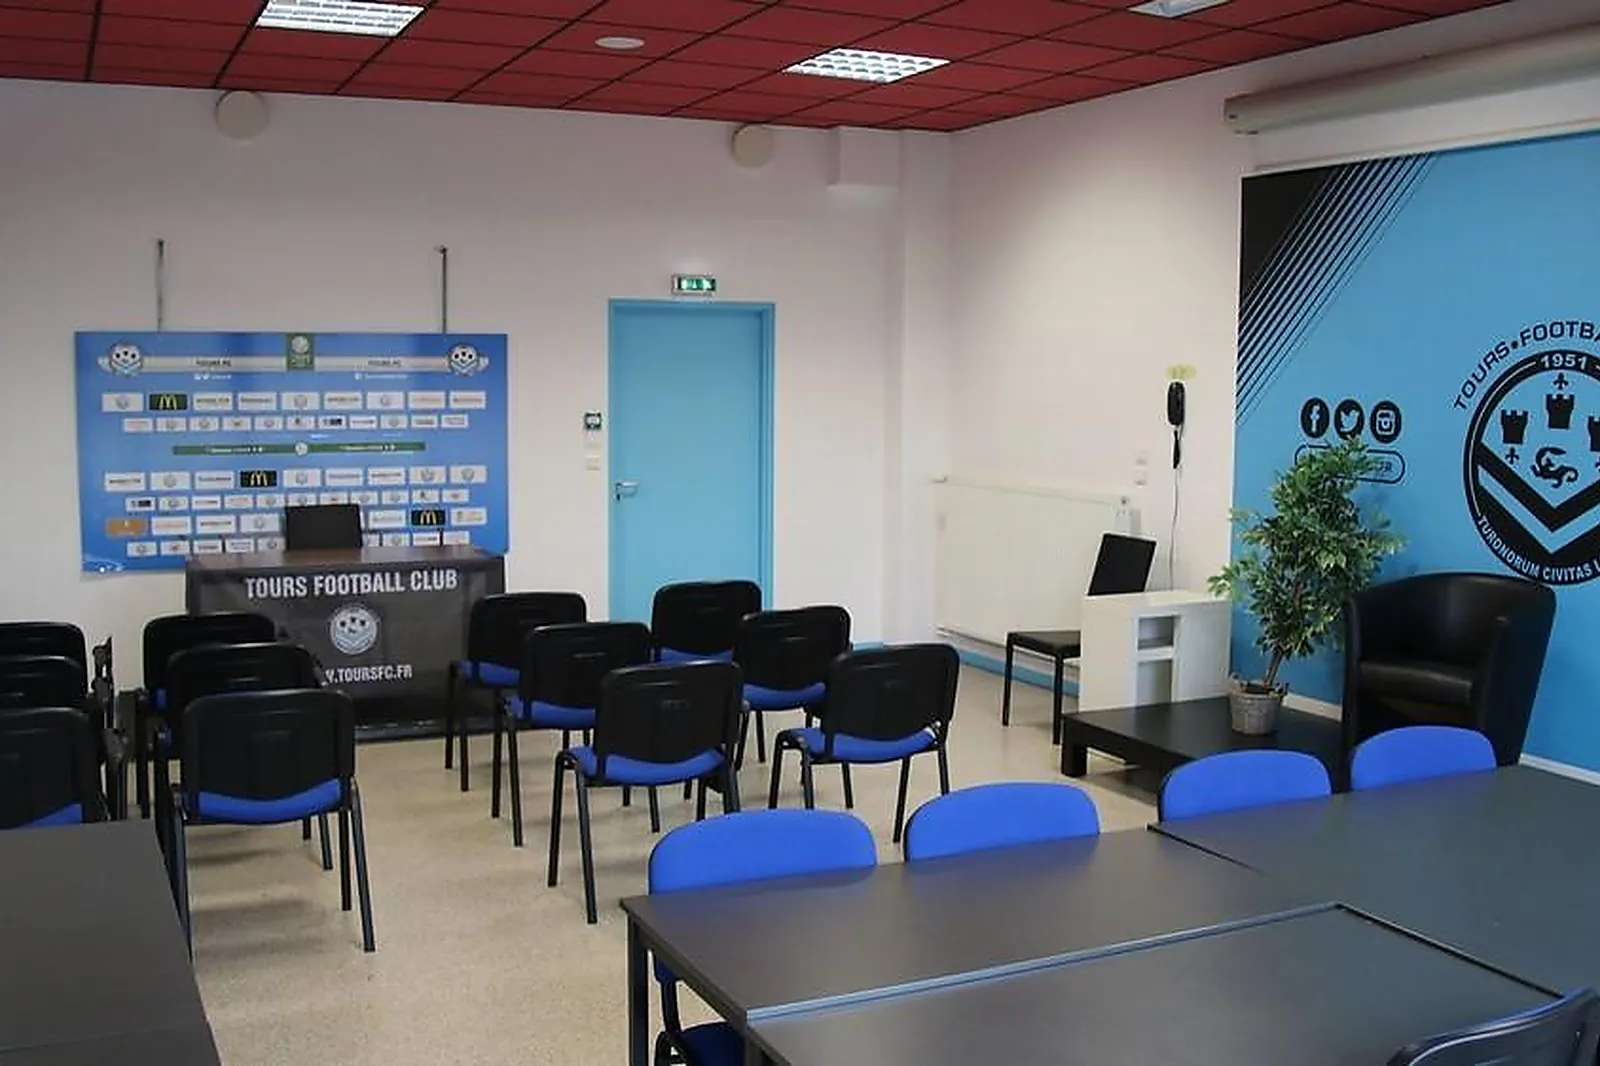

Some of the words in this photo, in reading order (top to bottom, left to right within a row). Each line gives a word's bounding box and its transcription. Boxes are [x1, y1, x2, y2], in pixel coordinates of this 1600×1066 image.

[1453, 340, 1510, 410] TOURS
[1519, 320, 1600, 347] FOOTB
[1540, 353, 1588, 370] 1951
[1477, 514, 1541, 578] TURONORUM
[1542, 562, 1593, 582] CIVITAS
[245, 575, 308, 599] TOURS
[313, 571, 405, 596] FOOTBALL
[410, 568, 458, 592] CLUB
